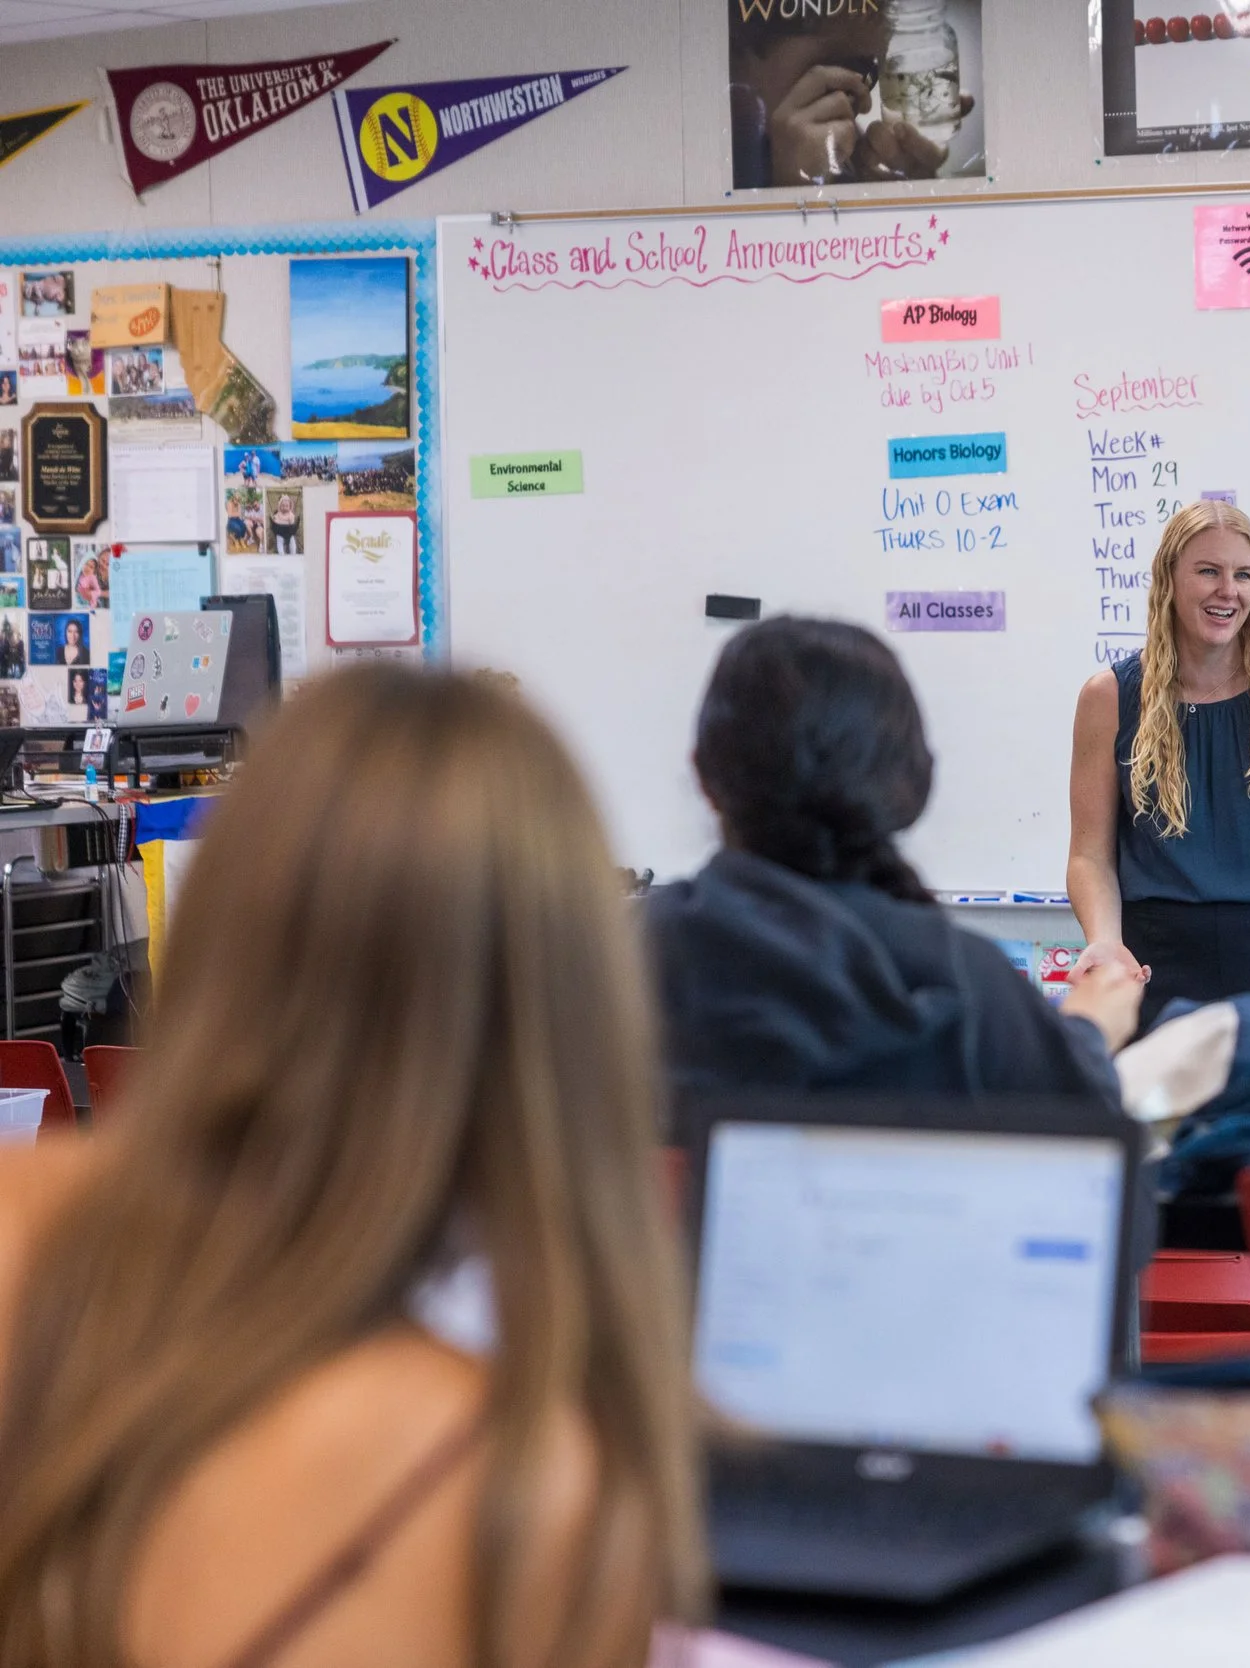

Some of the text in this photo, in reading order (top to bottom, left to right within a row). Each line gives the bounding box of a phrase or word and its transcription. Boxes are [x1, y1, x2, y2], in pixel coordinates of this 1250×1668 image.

[196, 59, 335, 100] THE UNIVERSITY OF
[439, 70, 606, 139] NORTHWESTERN WILDCATS
[378, 106, 420, 168] N
[489, 222, 924, 281] Class and School Announcements
[903, 304, 977, 326] AP Biology
[985, 346, 1020, 370] Unit
[880, 377, 996, 414] due by Oct 5
[1073, 367, 1200, 412] September
[893, 443, 1002, 463] Honors Biology
[489, 459, 562, 493] Environmental Science
[1092, 461, 1178, 493] Mon 29
[882, 488, 926, 521] Unit
[961, 491, 1019, 516] Exam
[1094, 502, 1146, 529] Tues
[956, 525, 1007, 552] 10-2
[1092, 537, 1135, 560] Wed
[1095, 567, 1152, 590] Thurs
[899, 602, 994, 619] All Classes
[1100, 597, 1131, 622] Fri
